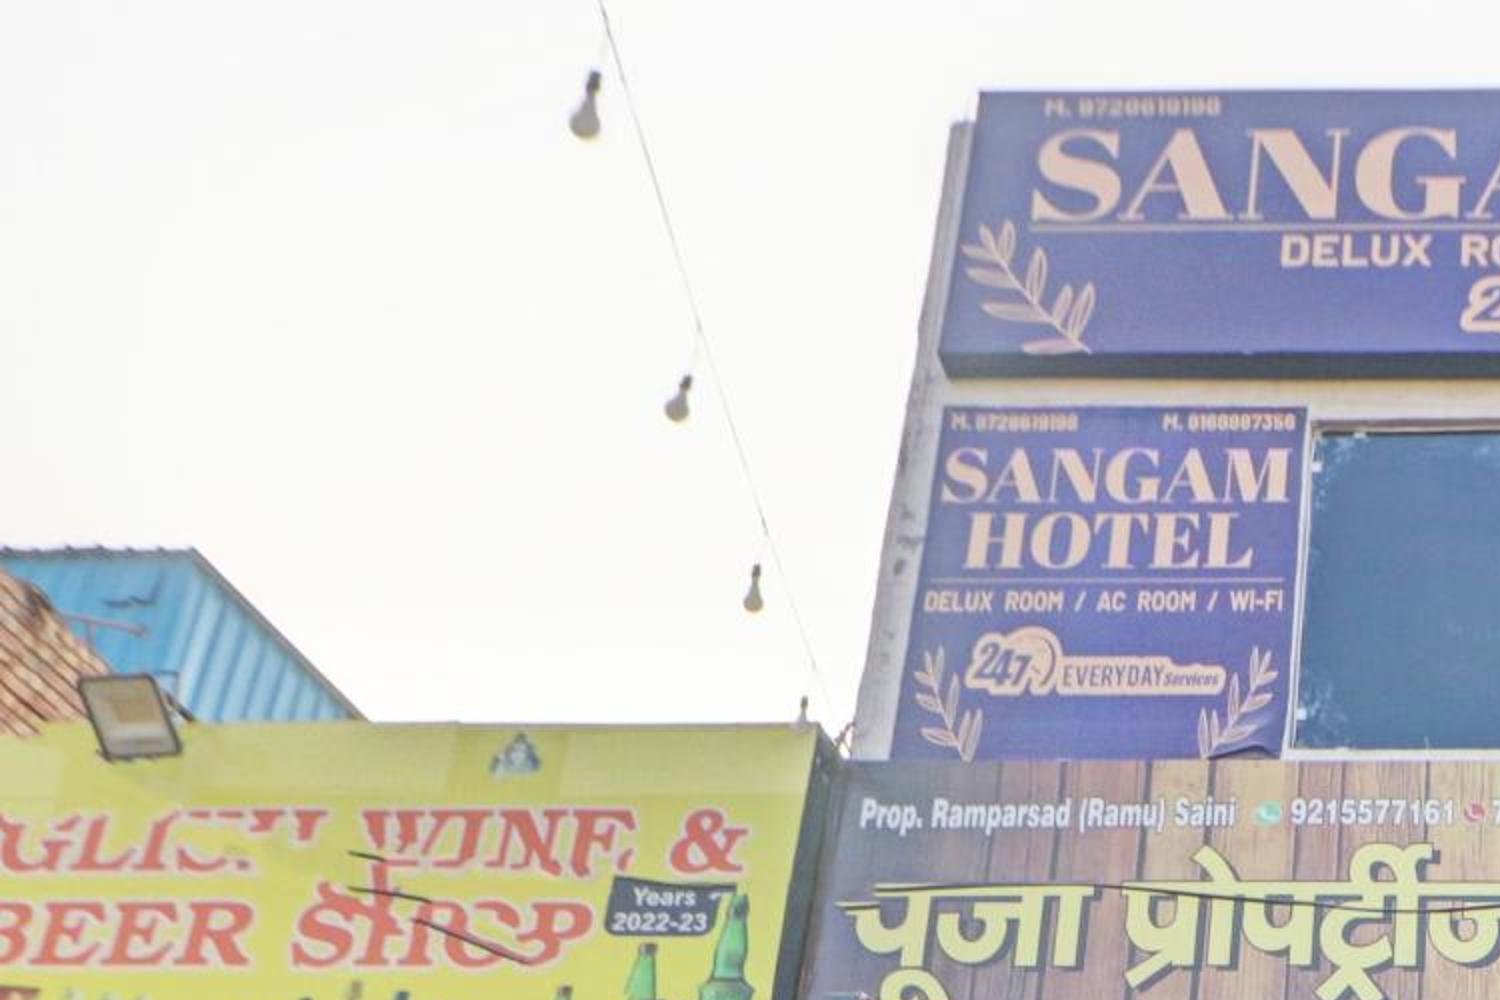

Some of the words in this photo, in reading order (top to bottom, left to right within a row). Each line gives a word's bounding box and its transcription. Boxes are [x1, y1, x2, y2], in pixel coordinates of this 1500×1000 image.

[1280, 234, 1432, 269] DELUX
[941, 446, 1293, 504] SANGAM
[962, 511, 1254, 570] HOTEL
[924, 589, 992, 612] DELUX
[1003, 589, 1063, 612] ROOM
[1096, 589, 1126, 612] AC
[1136, 589, 1196, 612] ROOM
[1062, 664, 1165, 687] EVERYDAY
[859, 798, 924, 837] Prop.
[930, 798, 1071, 835] Ramparsad
[1078, 798, 1166, 833] (Ramu)
[1174, 797, 1236, 827] Saini
[1290, 798, 1455, 826] 9215577161
[670, 808, 749, 874] &
[633, 887, 696, 908] Years
[0, 901, 255, 967] BEER
[611, 911, 710, 934] 2022-23
